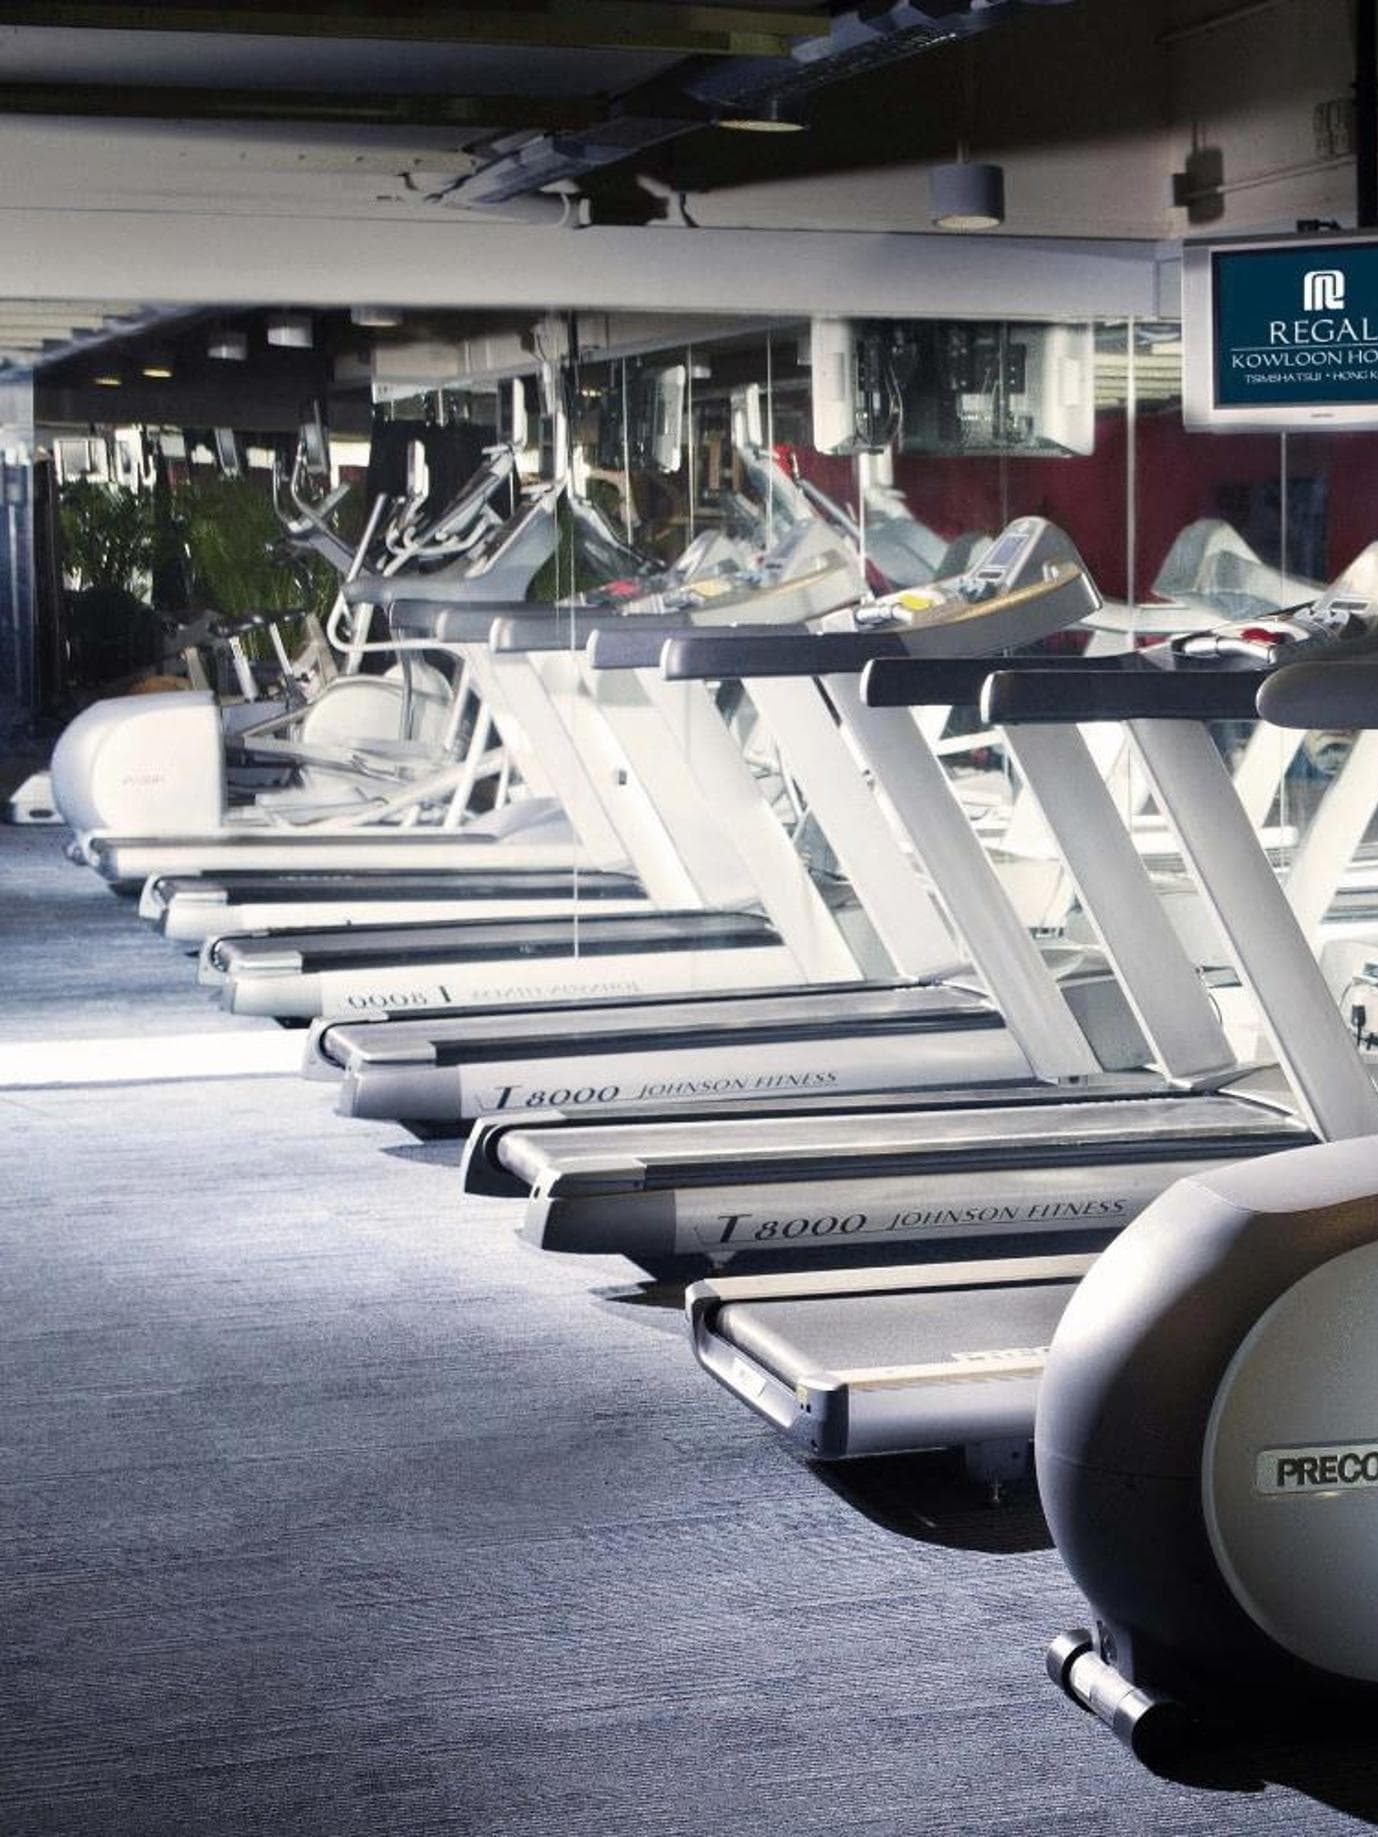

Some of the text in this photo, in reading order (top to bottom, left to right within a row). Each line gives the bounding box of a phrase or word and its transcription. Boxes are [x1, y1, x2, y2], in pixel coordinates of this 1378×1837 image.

[1269, 317, 1378, 345] REGAL
[1231, 351, 1342, 369] KOWLOON
[636, 1078, 749, 1099] JOHNSON
[754, 1072, 837, 1087] FITNESS
[885, 1206, 1019, 1232] JOHNSON
[1027, 1199, 1126, 1219] FITNESS
